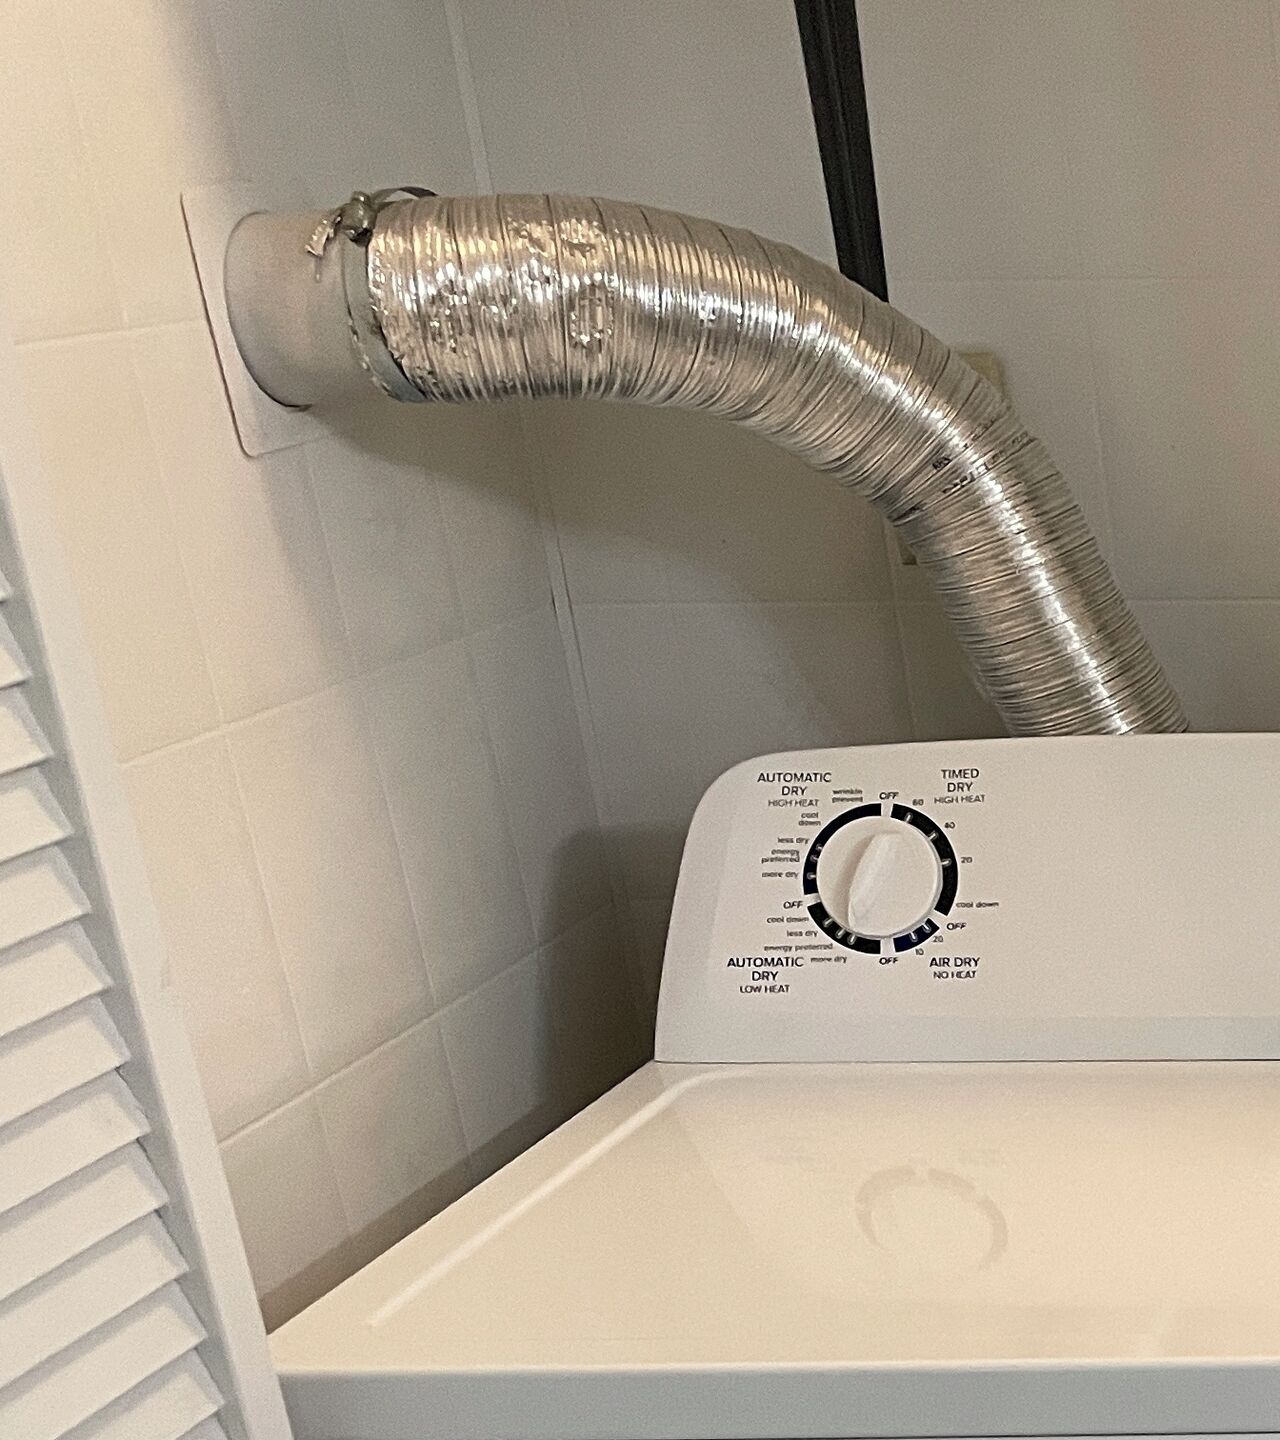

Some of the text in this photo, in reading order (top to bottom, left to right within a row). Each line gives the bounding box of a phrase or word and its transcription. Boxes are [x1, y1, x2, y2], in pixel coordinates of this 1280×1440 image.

[757, 772, 832, 783] AUTOMATIC
[941, 768, 980, 779] TIMED
[781, 786, 807, 796] DRY
[947, 782, 973, 793] DRY
[879, 791, 899, 800] OFF
[934, 794, 985, 804] HIGH HEAT
[768, 799, 819, 807] HIGH HEAT
[785, 871, 799, 880] dry
[783, 901, 803, 909] OFF
[766, 916, 784, 924] cool
[946, 922, 967, 931] OFF
[805, 930, 818, 938] dry
[727, 957, 805, 968] AUTOMATIC
[834, 956, 847, 964] dry
[879, 957, 899, 965] OFF
[929, 957, 980, 968] AIR DRY
[751, 971, 779, 981] DRY
[933, 970, 977, 979] NO HEAT
[740, 984, 790, 994] LOW HEAT
